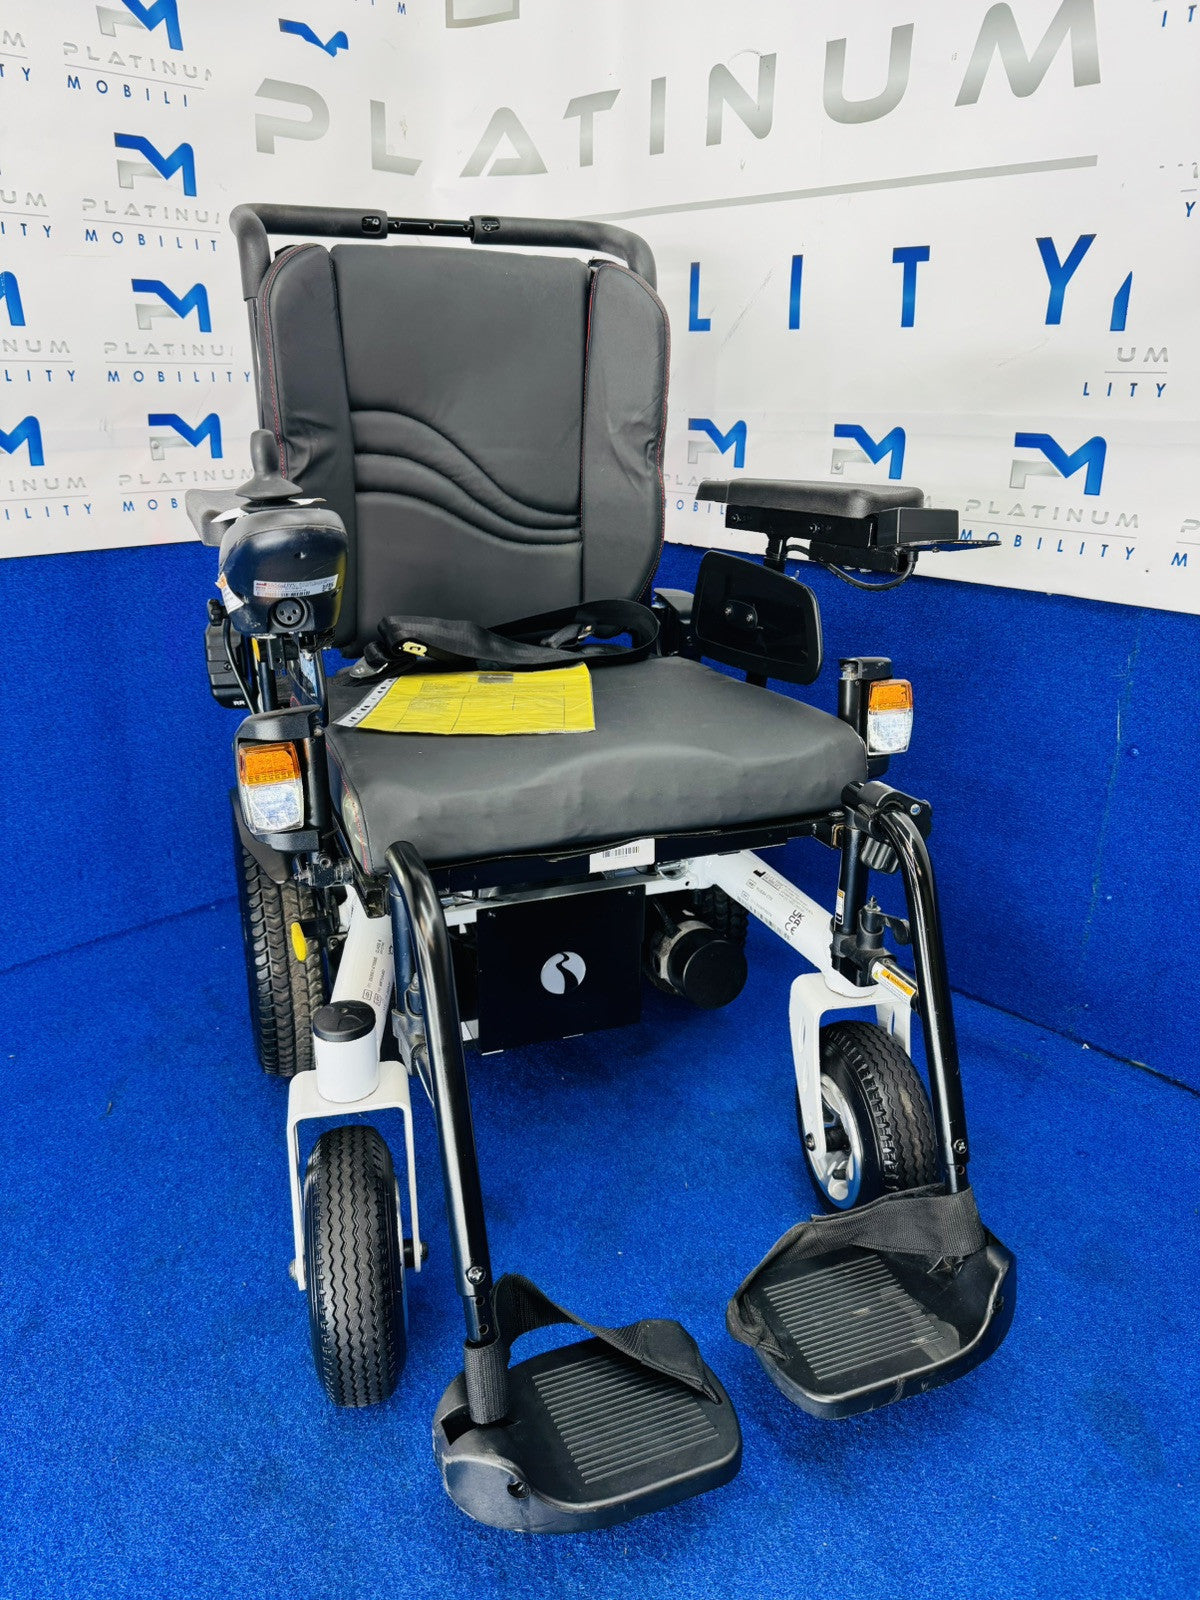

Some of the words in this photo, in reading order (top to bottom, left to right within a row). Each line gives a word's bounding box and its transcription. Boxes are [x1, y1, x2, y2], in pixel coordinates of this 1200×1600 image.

[254, 0, 1101, 178] PLATINUM
[82, 198, 220, 225] PLATINU
[103, 341, 234, 357] PLATINU
[107, 370, 251, 383] MOBILITY
[964, 498, 1139, 529] PLATINUM
[960, 529, 1135, 561] MOBILITY
